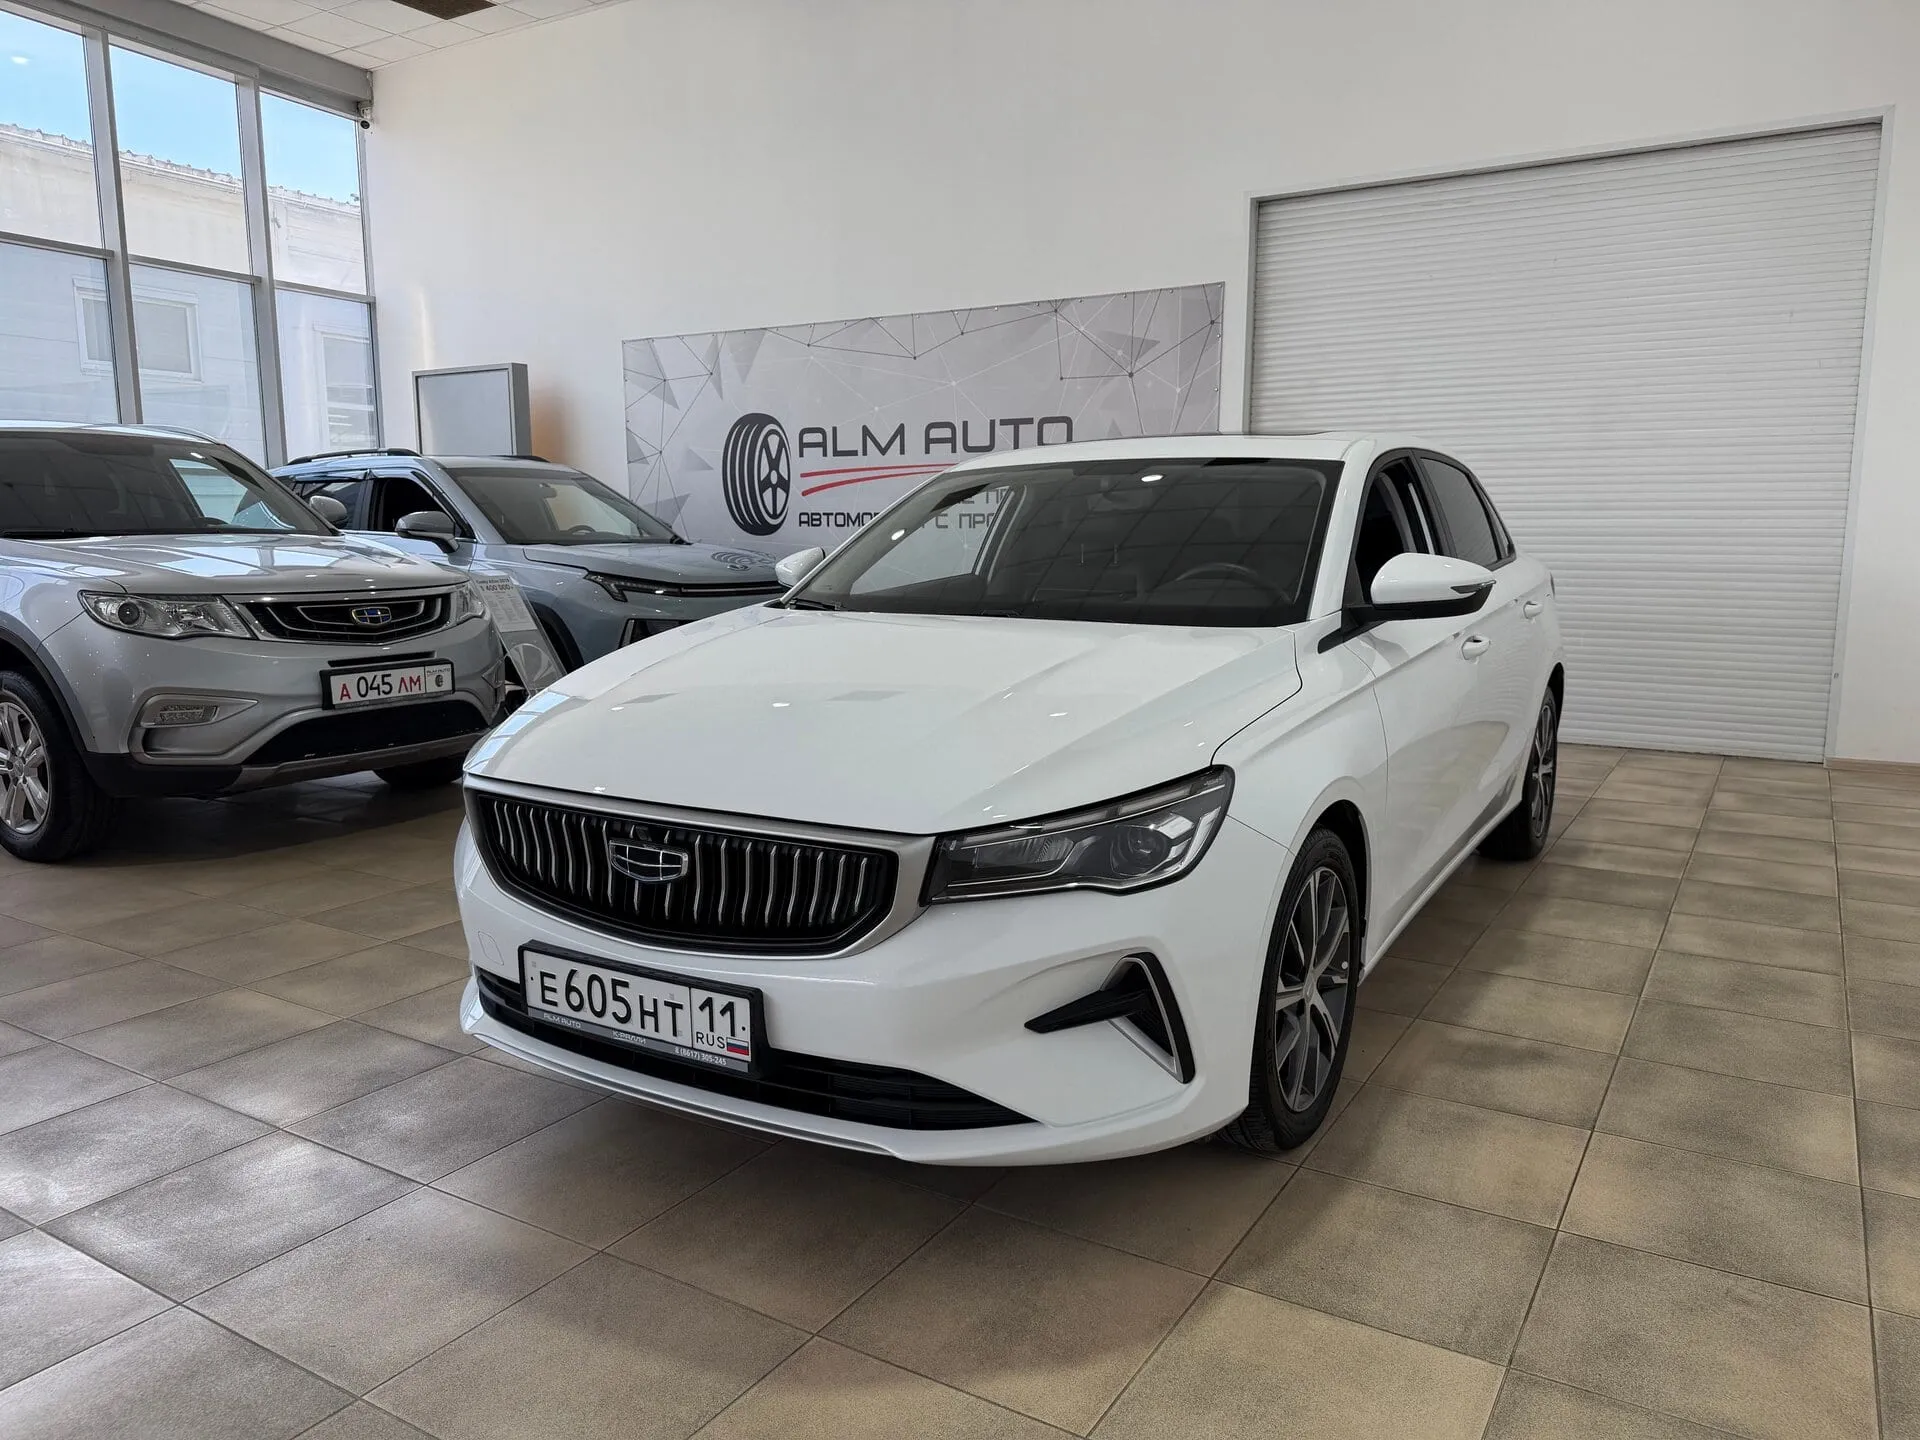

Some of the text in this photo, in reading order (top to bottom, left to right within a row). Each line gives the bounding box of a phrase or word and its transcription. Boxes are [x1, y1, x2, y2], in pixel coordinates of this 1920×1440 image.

[798, 416, 1074, 458] ALM AUTO
[798, 512, 880, 528] АВТОМО
[356, 673, 393, 698] 045
[698, 996, 737, 1037] 11
[696, 1031, 726, 1050] RUS
